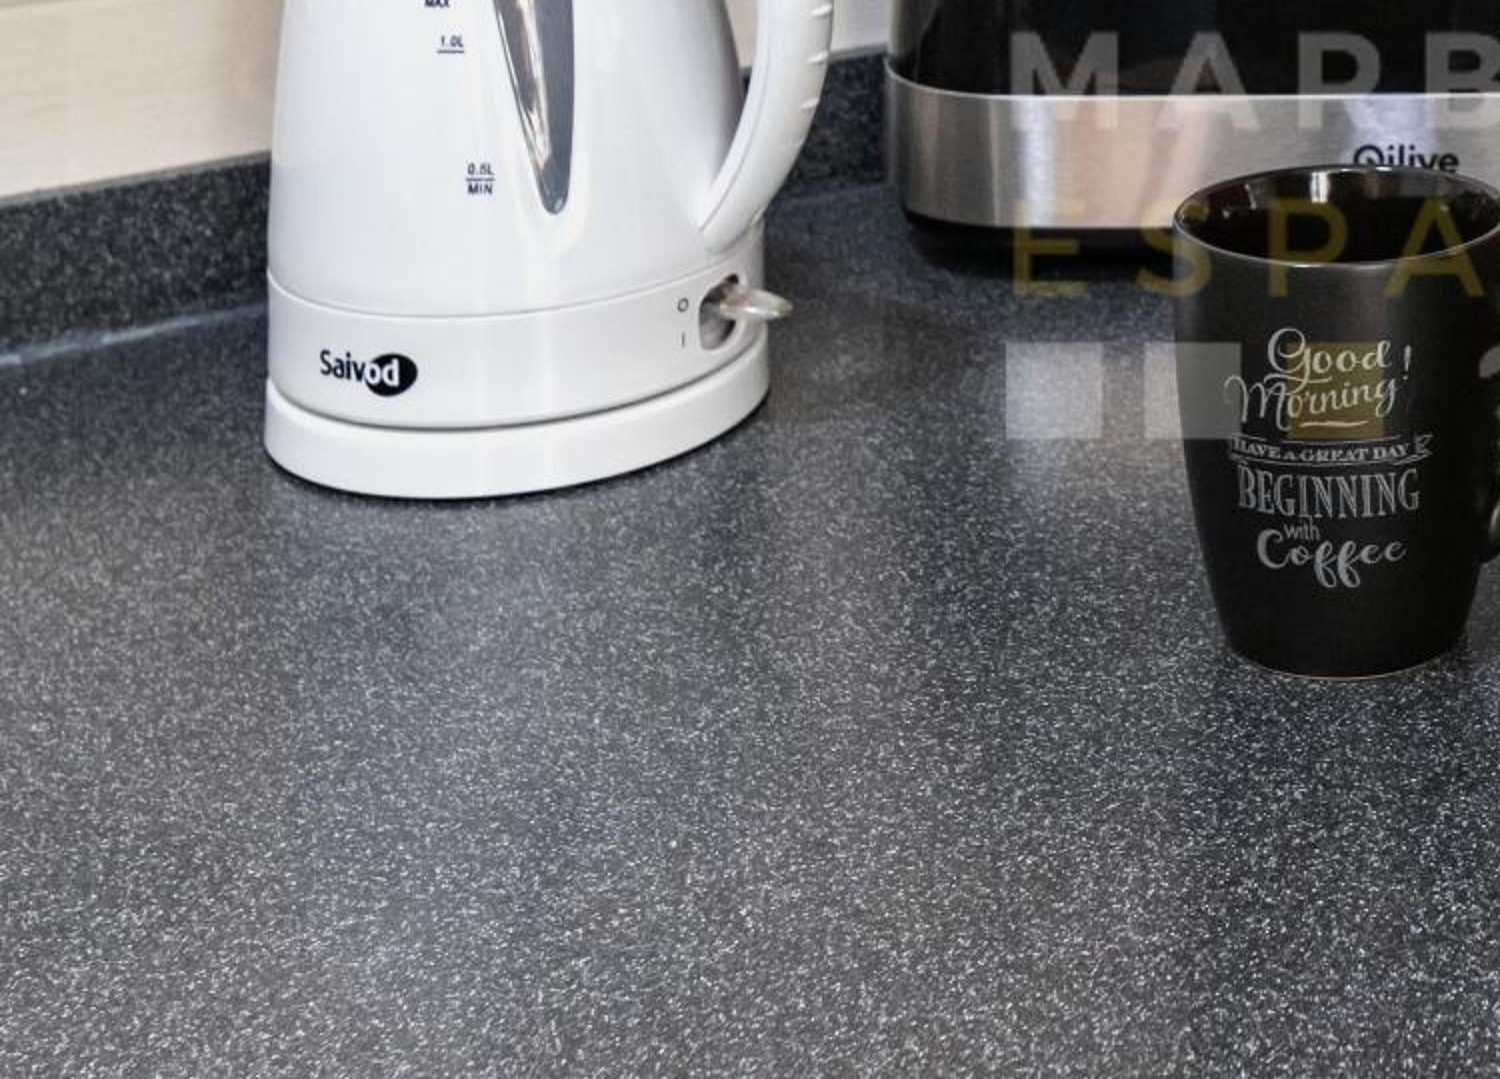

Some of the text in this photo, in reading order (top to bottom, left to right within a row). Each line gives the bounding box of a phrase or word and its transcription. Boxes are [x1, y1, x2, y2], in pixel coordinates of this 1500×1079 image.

[1353, 144, 1459, 173] Qilive
[467, 183, 493, 196] MIN
[320, 349, 399, 387] Saivod
[1233, 435, 1411, 462] HAVE A GREAT DAY
[1238, 464, 1420, 518] BEGINNING
[1284, 517, 1322, 541] with
[1257, 528, 1407, 588] Coffee
